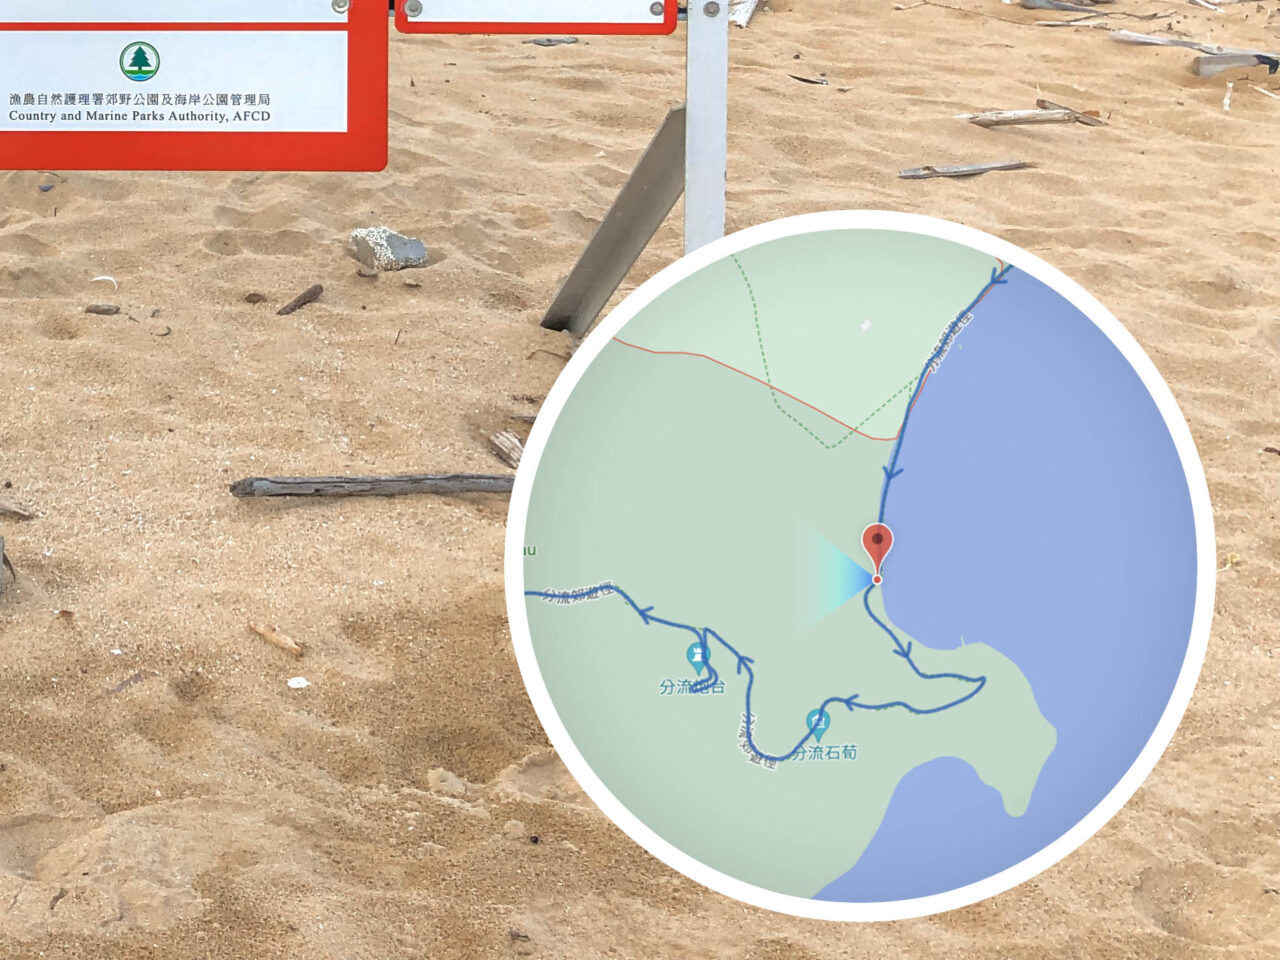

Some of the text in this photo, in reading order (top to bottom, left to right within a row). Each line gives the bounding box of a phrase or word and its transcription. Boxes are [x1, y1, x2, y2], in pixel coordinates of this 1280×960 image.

[9, 92, 270, 106] 漁農自然護理署郊野公園及海岸公園管理局
[8, 109, 270, 123] Country and Marine Parks Authority, AFCD
